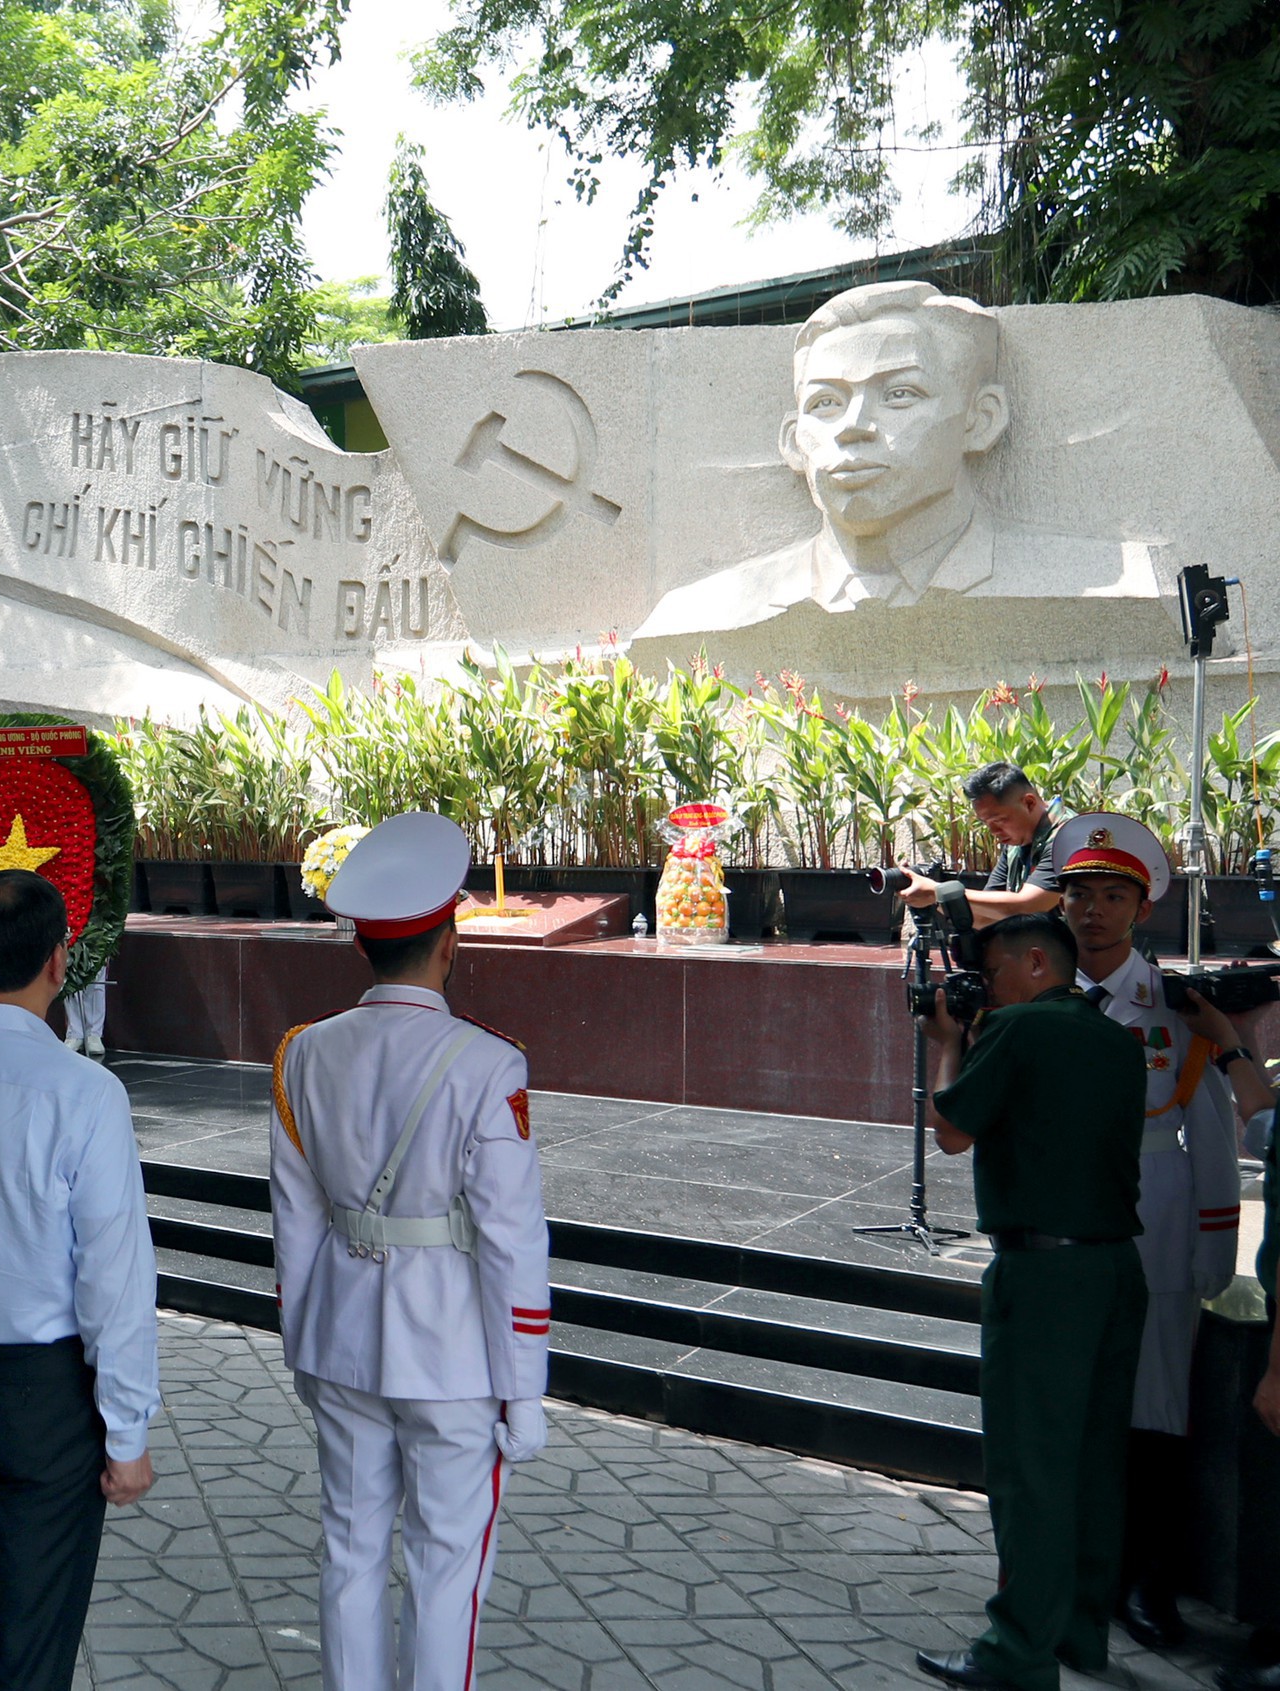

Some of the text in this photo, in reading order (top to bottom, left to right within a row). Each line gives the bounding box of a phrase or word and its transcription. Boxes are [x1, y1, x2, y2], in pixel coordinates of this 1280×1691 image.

[72, 402, 372, 544] HÃY GIỮ VỮNG
[22, 484, 431, 642] CHÍ KHÍ CHIẾN ĐẤU
[17, 743, 52, 755] VIẾNG
[31, 731, 40, 743] BỘ
[41, 730, 58, 741] QUỐC
